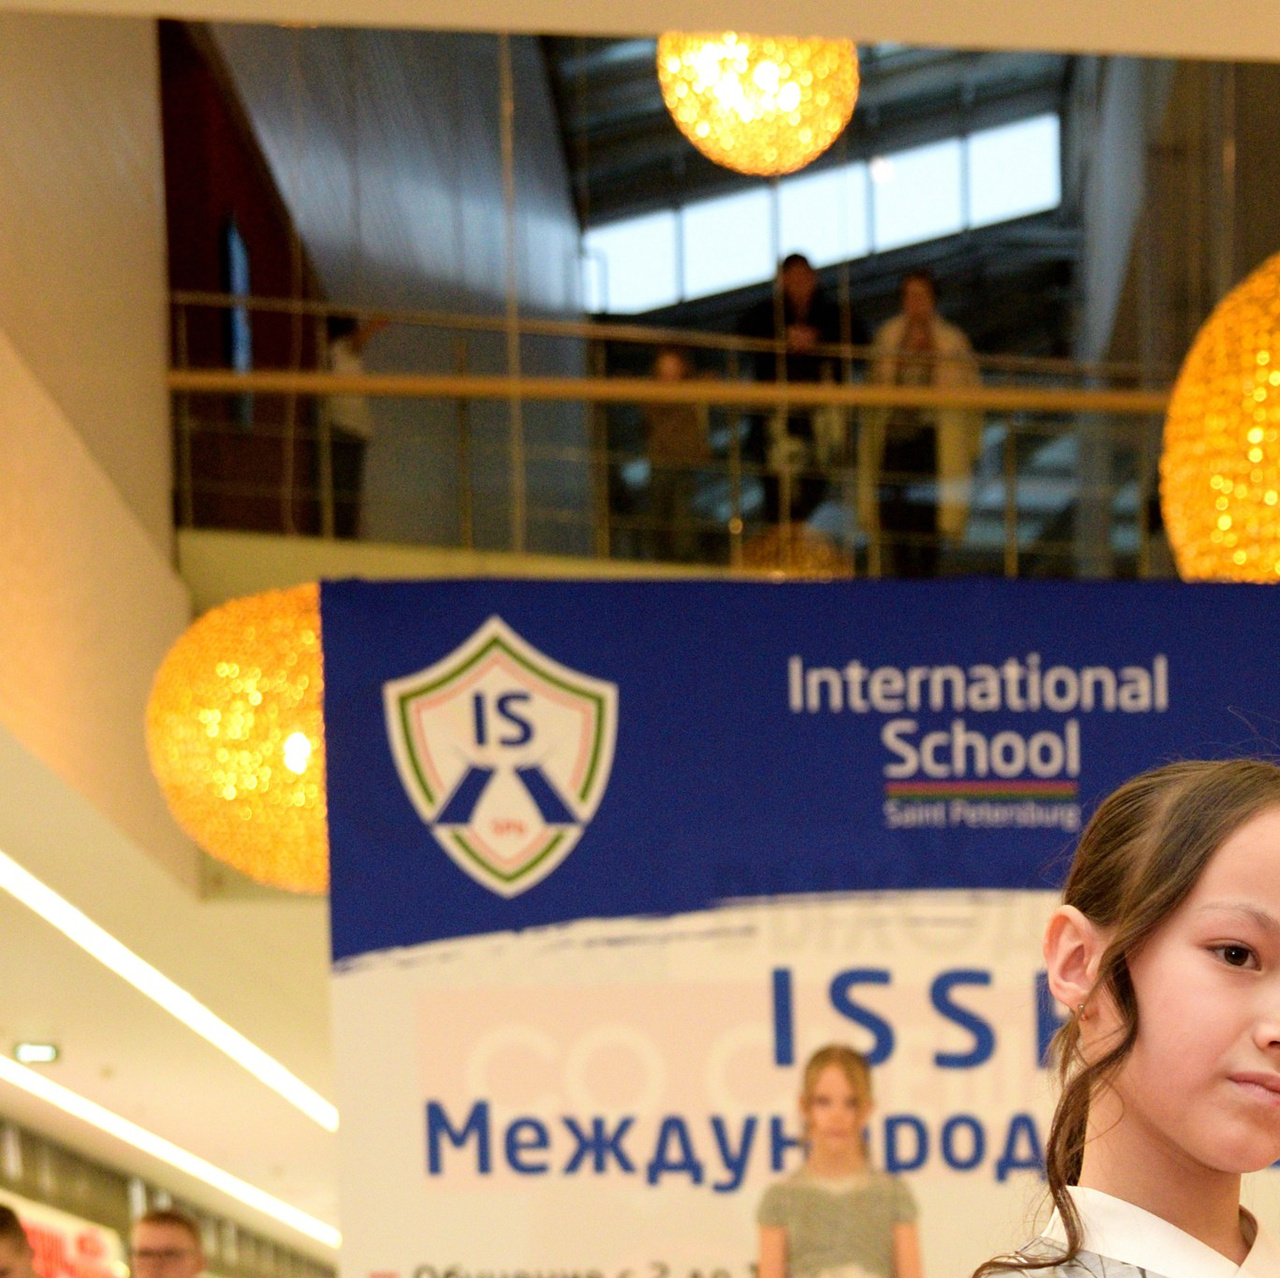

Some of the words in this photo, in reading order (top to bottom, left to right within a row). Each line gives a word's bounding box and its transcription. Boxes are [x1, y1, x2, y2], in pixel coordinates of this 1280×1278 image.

[788, 653, 1169, 713] International
[472, 691, 537, 748] IS
[882, 719, 1081, 779] School
